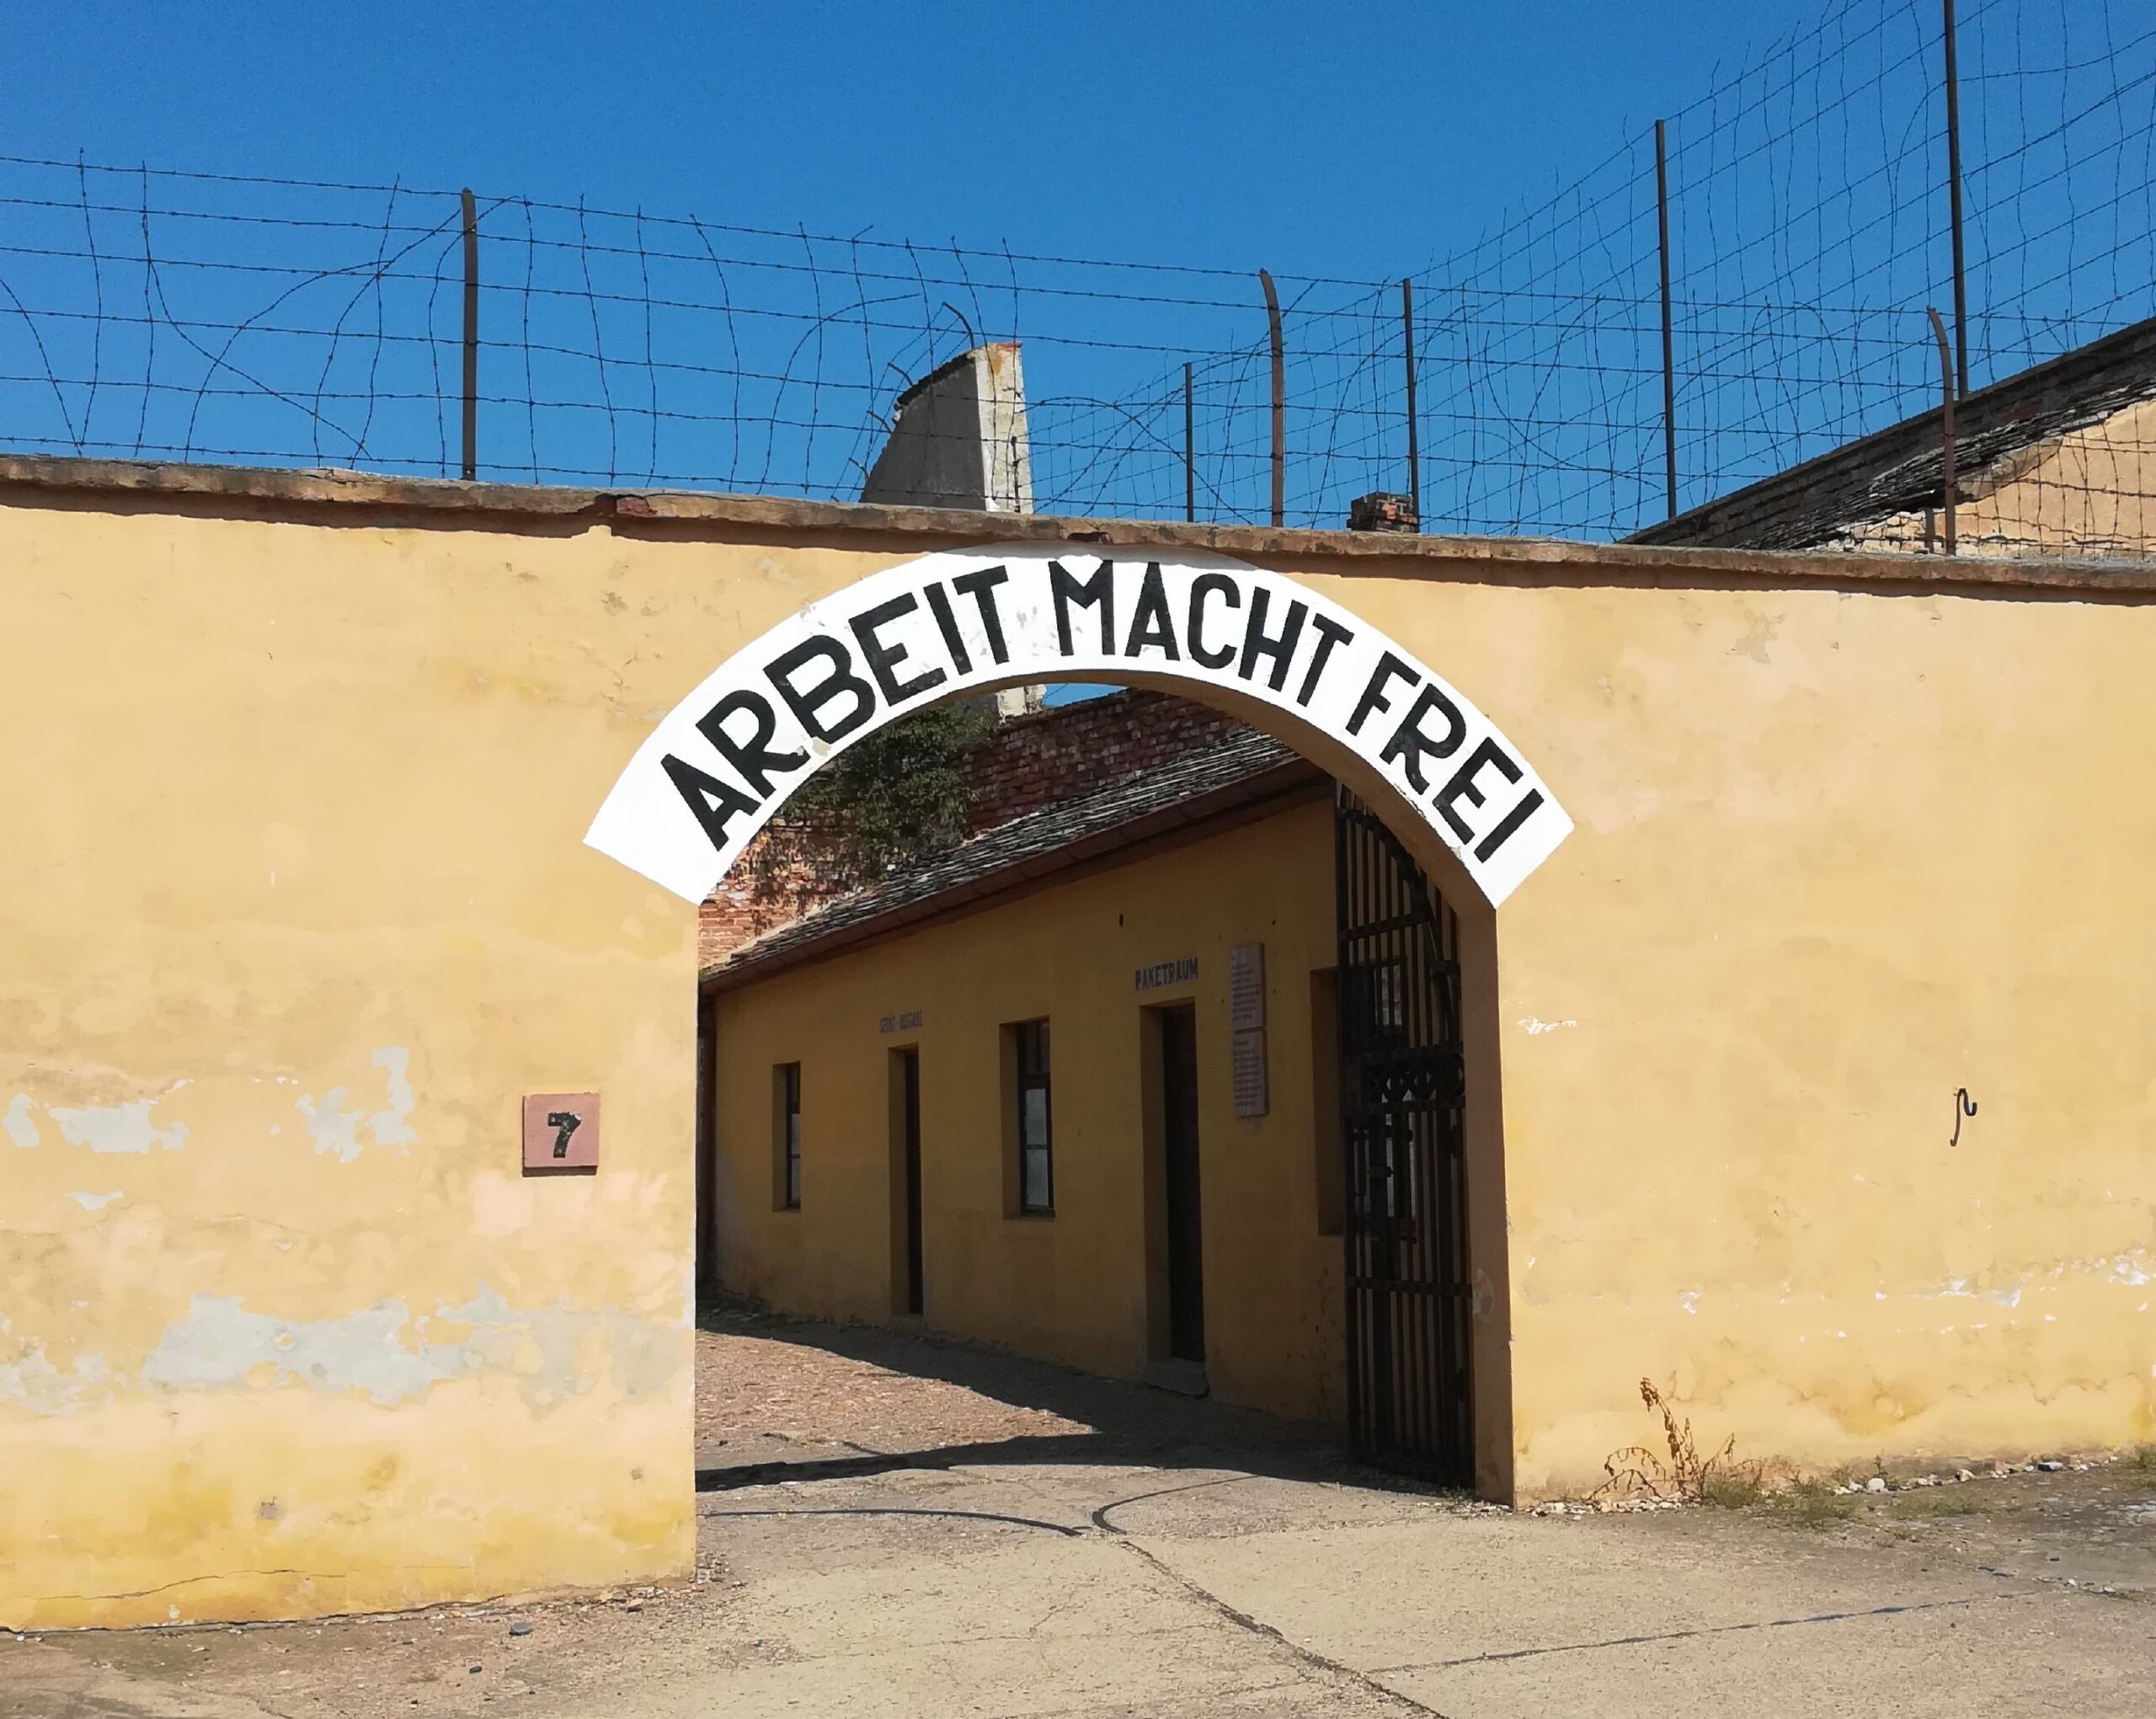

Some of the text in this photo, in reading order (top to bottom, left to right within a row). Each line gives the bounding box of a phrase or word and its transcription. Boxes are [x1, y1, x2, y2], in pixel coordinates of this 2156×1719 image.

[660, 560, 1545, 863] ARBEIT MACHT FREI
[1134, 957, 1198, 991] PAKETRAUM
[547, 1112, 582, 1158] 7
